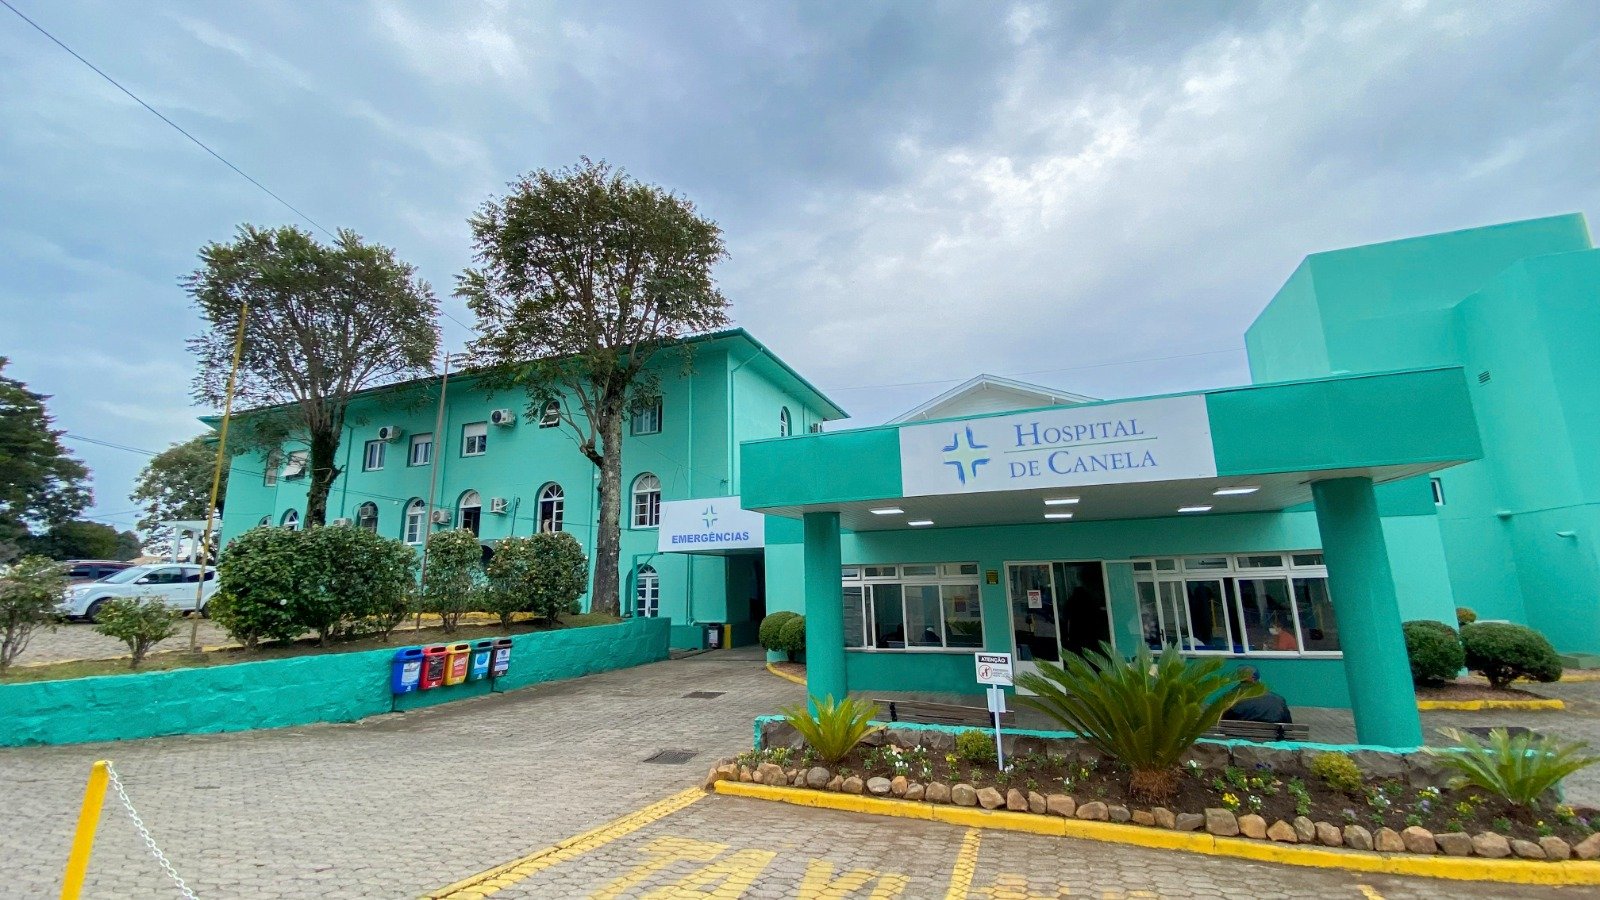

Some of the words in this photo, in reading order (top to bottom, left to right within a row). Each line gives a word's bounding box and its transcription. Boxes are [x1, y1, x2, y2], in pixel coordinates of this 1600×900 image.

[1014, 419, 1144, 447] HOSPITAL
[1009, 460, 1041, 479] DE
[1047, 449, 1158, 475] CANELA
[671, 531, 749, 544] EMERGÊNCIAS
